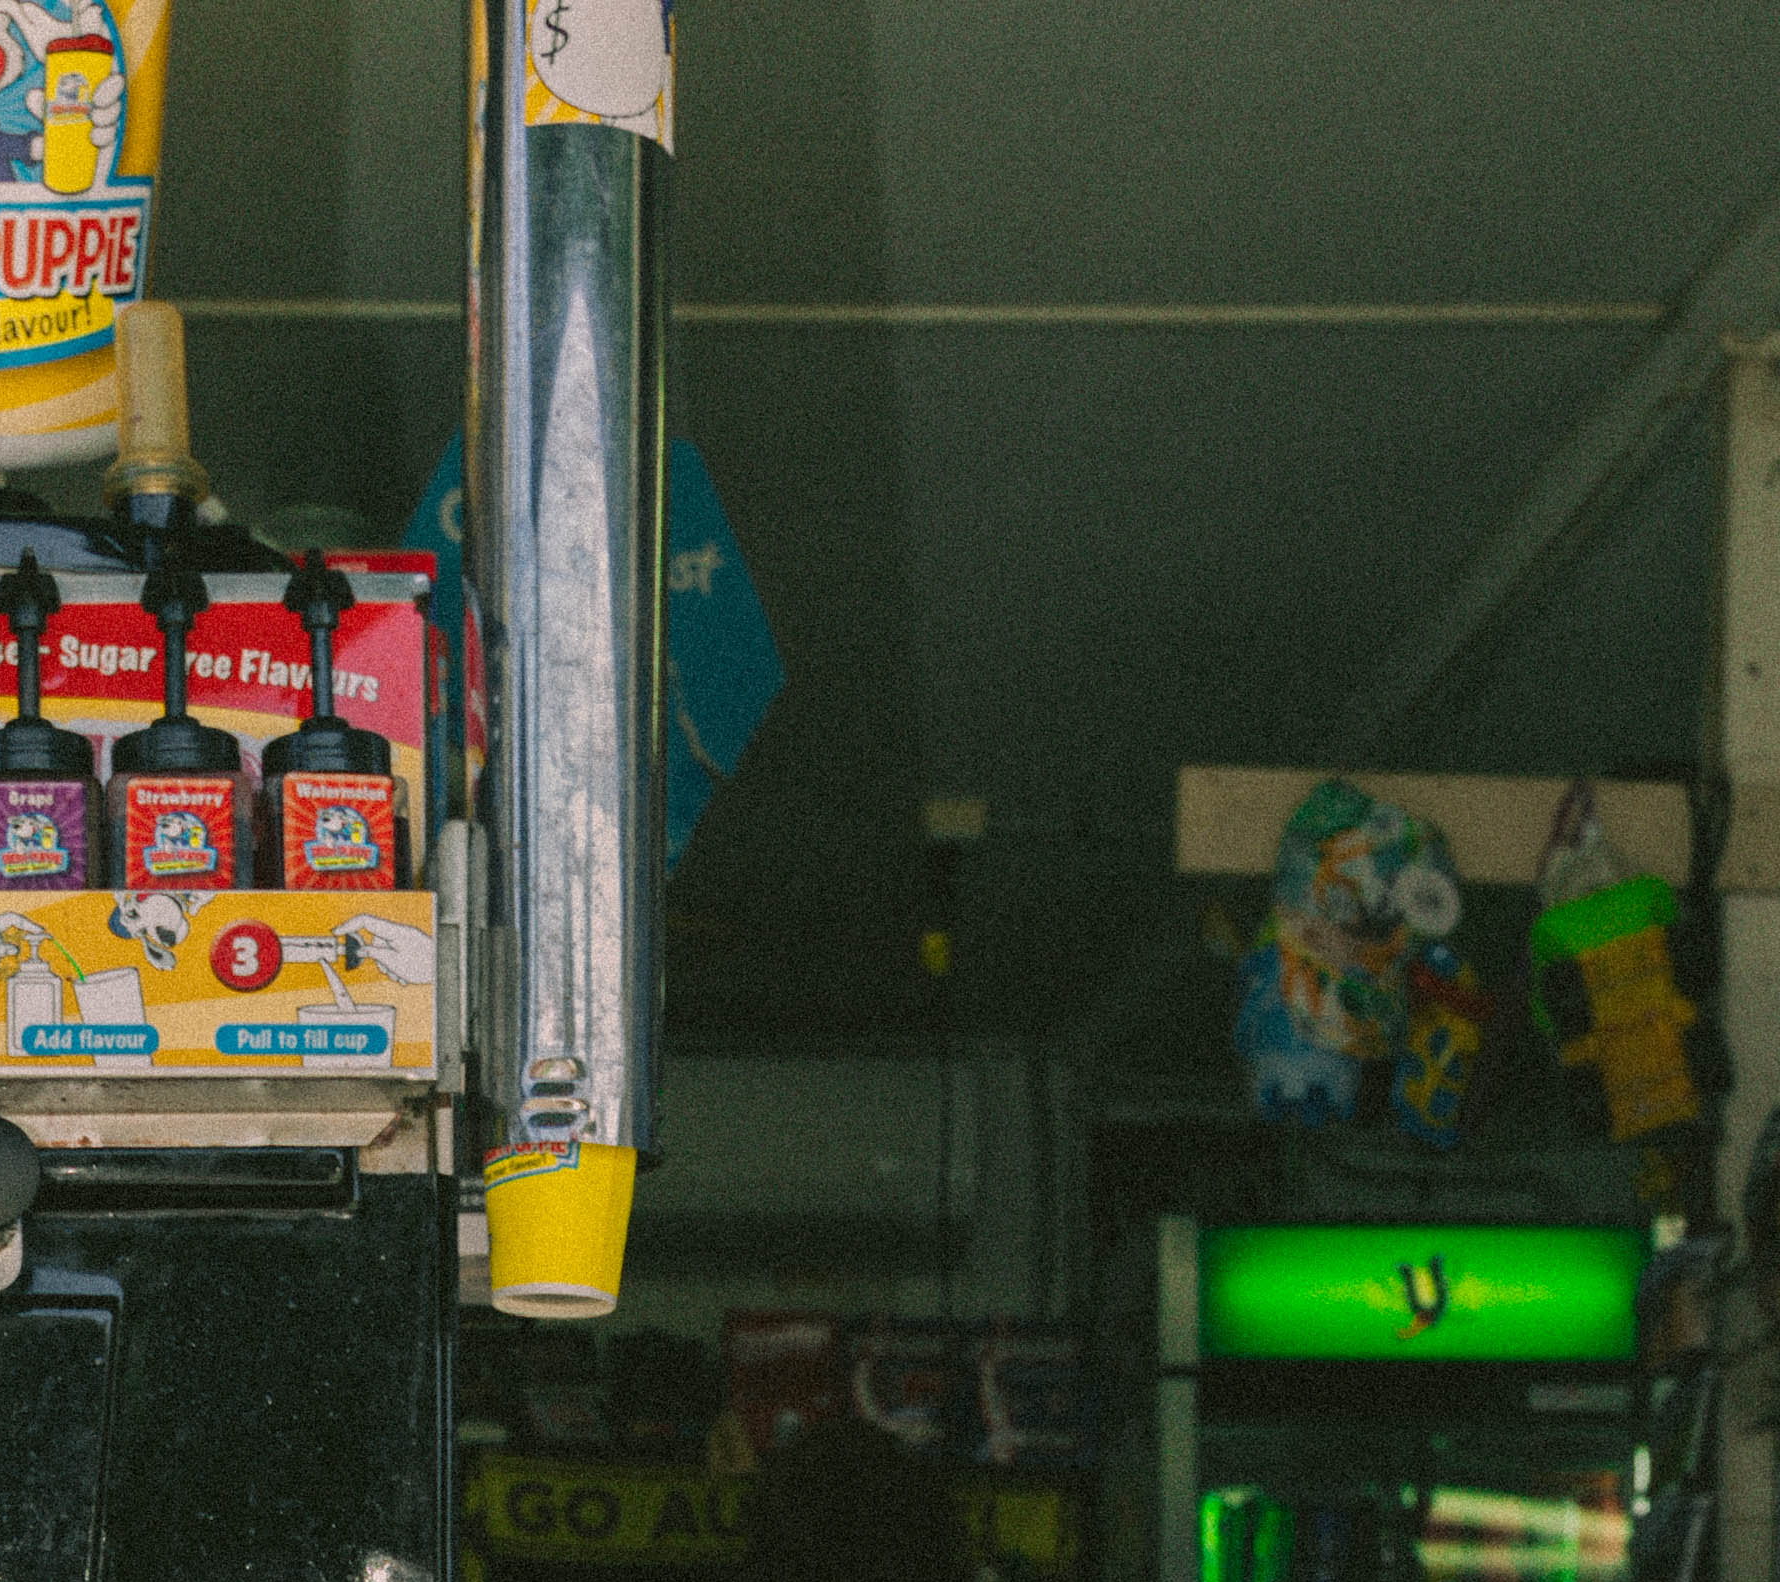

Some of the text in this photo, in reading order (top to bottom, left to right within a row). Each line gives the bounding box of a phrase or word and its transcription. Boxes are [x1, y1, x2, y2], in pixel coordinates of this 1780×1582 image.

[59, 633, 157, 677] Sugar
[184, 651, 233, 681] ree
[8, 790, 54, 809] Grape
[136, 786, 224, 809] Strawberry
[295, 782, 388, 803] Watermelon
[230, 936, 260, 977] 3
[33, 1028, 147, 1049] Add flavour
[236, 1028, 369, 1054] Pull to fill cup
[505, 1480, 622, 1540] GO
